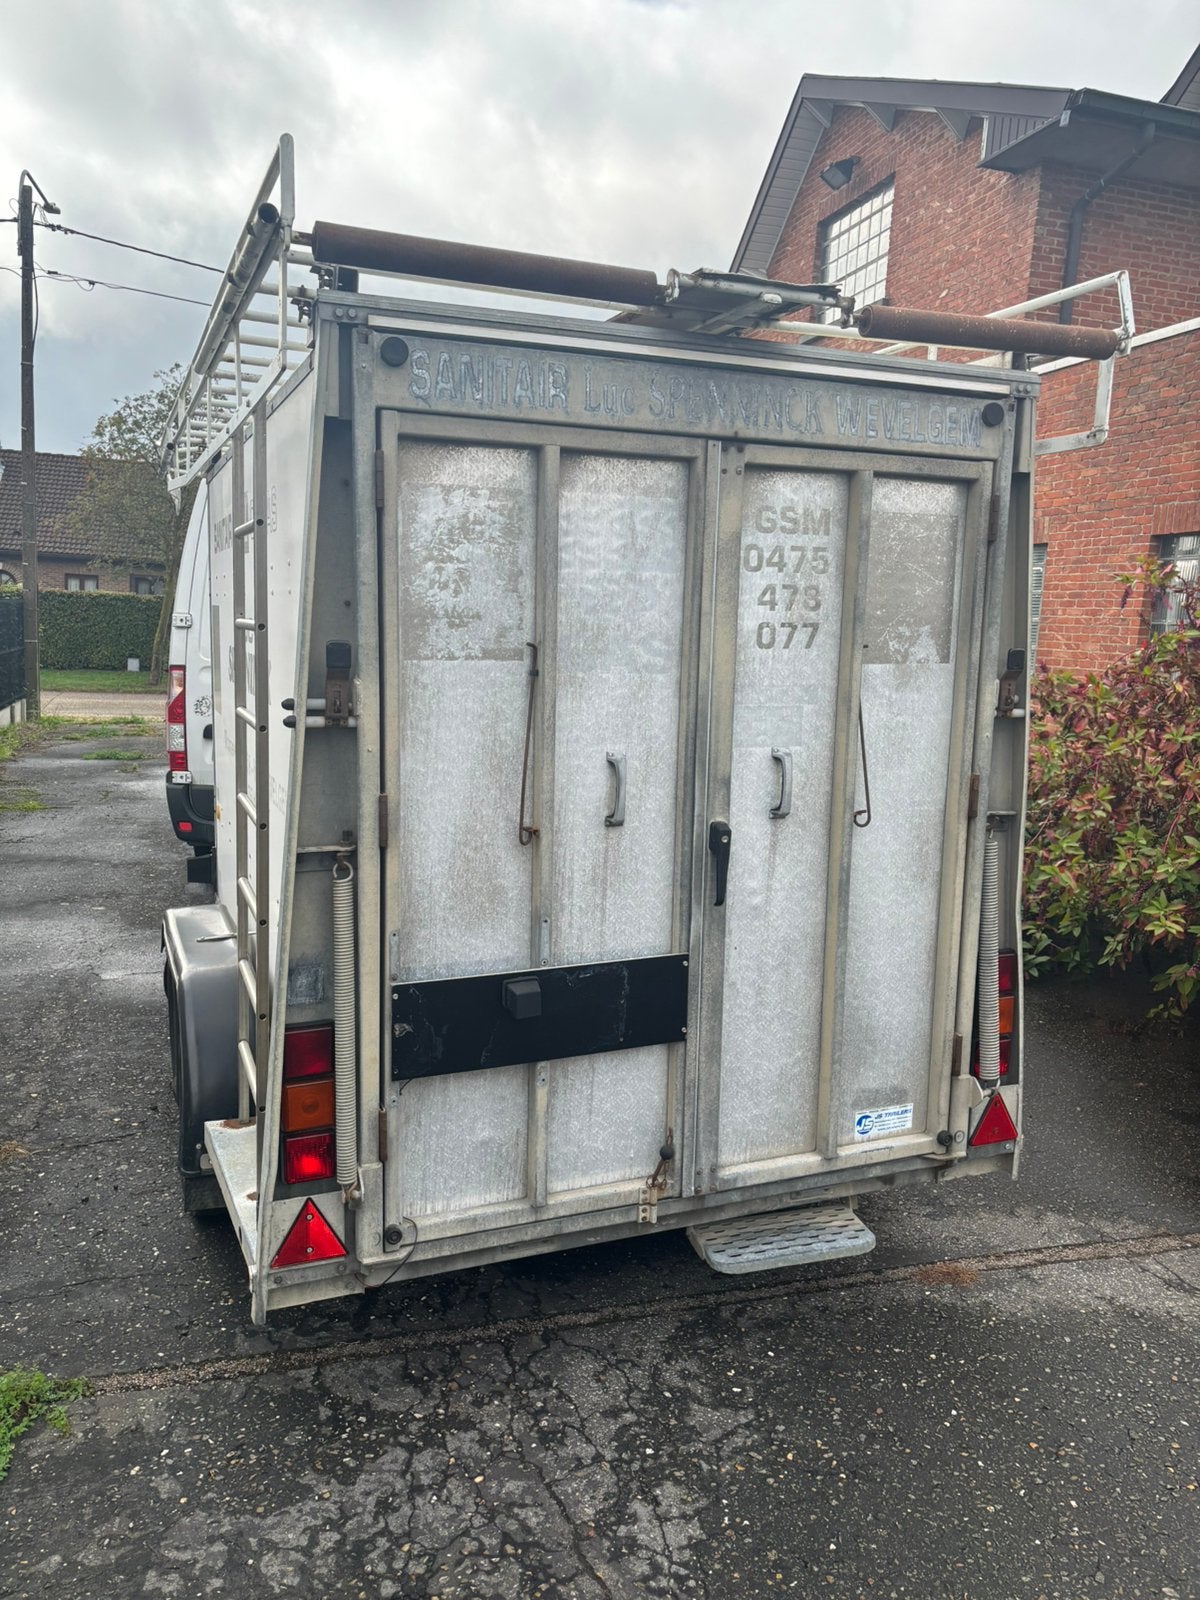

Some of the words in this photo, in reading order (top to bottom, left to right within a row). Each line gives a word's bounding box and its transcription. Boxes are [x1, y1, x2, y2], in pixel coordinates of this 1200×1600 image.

[409, 349, 569, 411] SANITAIR
[834, 391, 983, 447] WEVELGEM
[755, 505, 832, 536] GSM
[743, 543, 829, 575] 0475
[755, 621, 820, 650] 077
